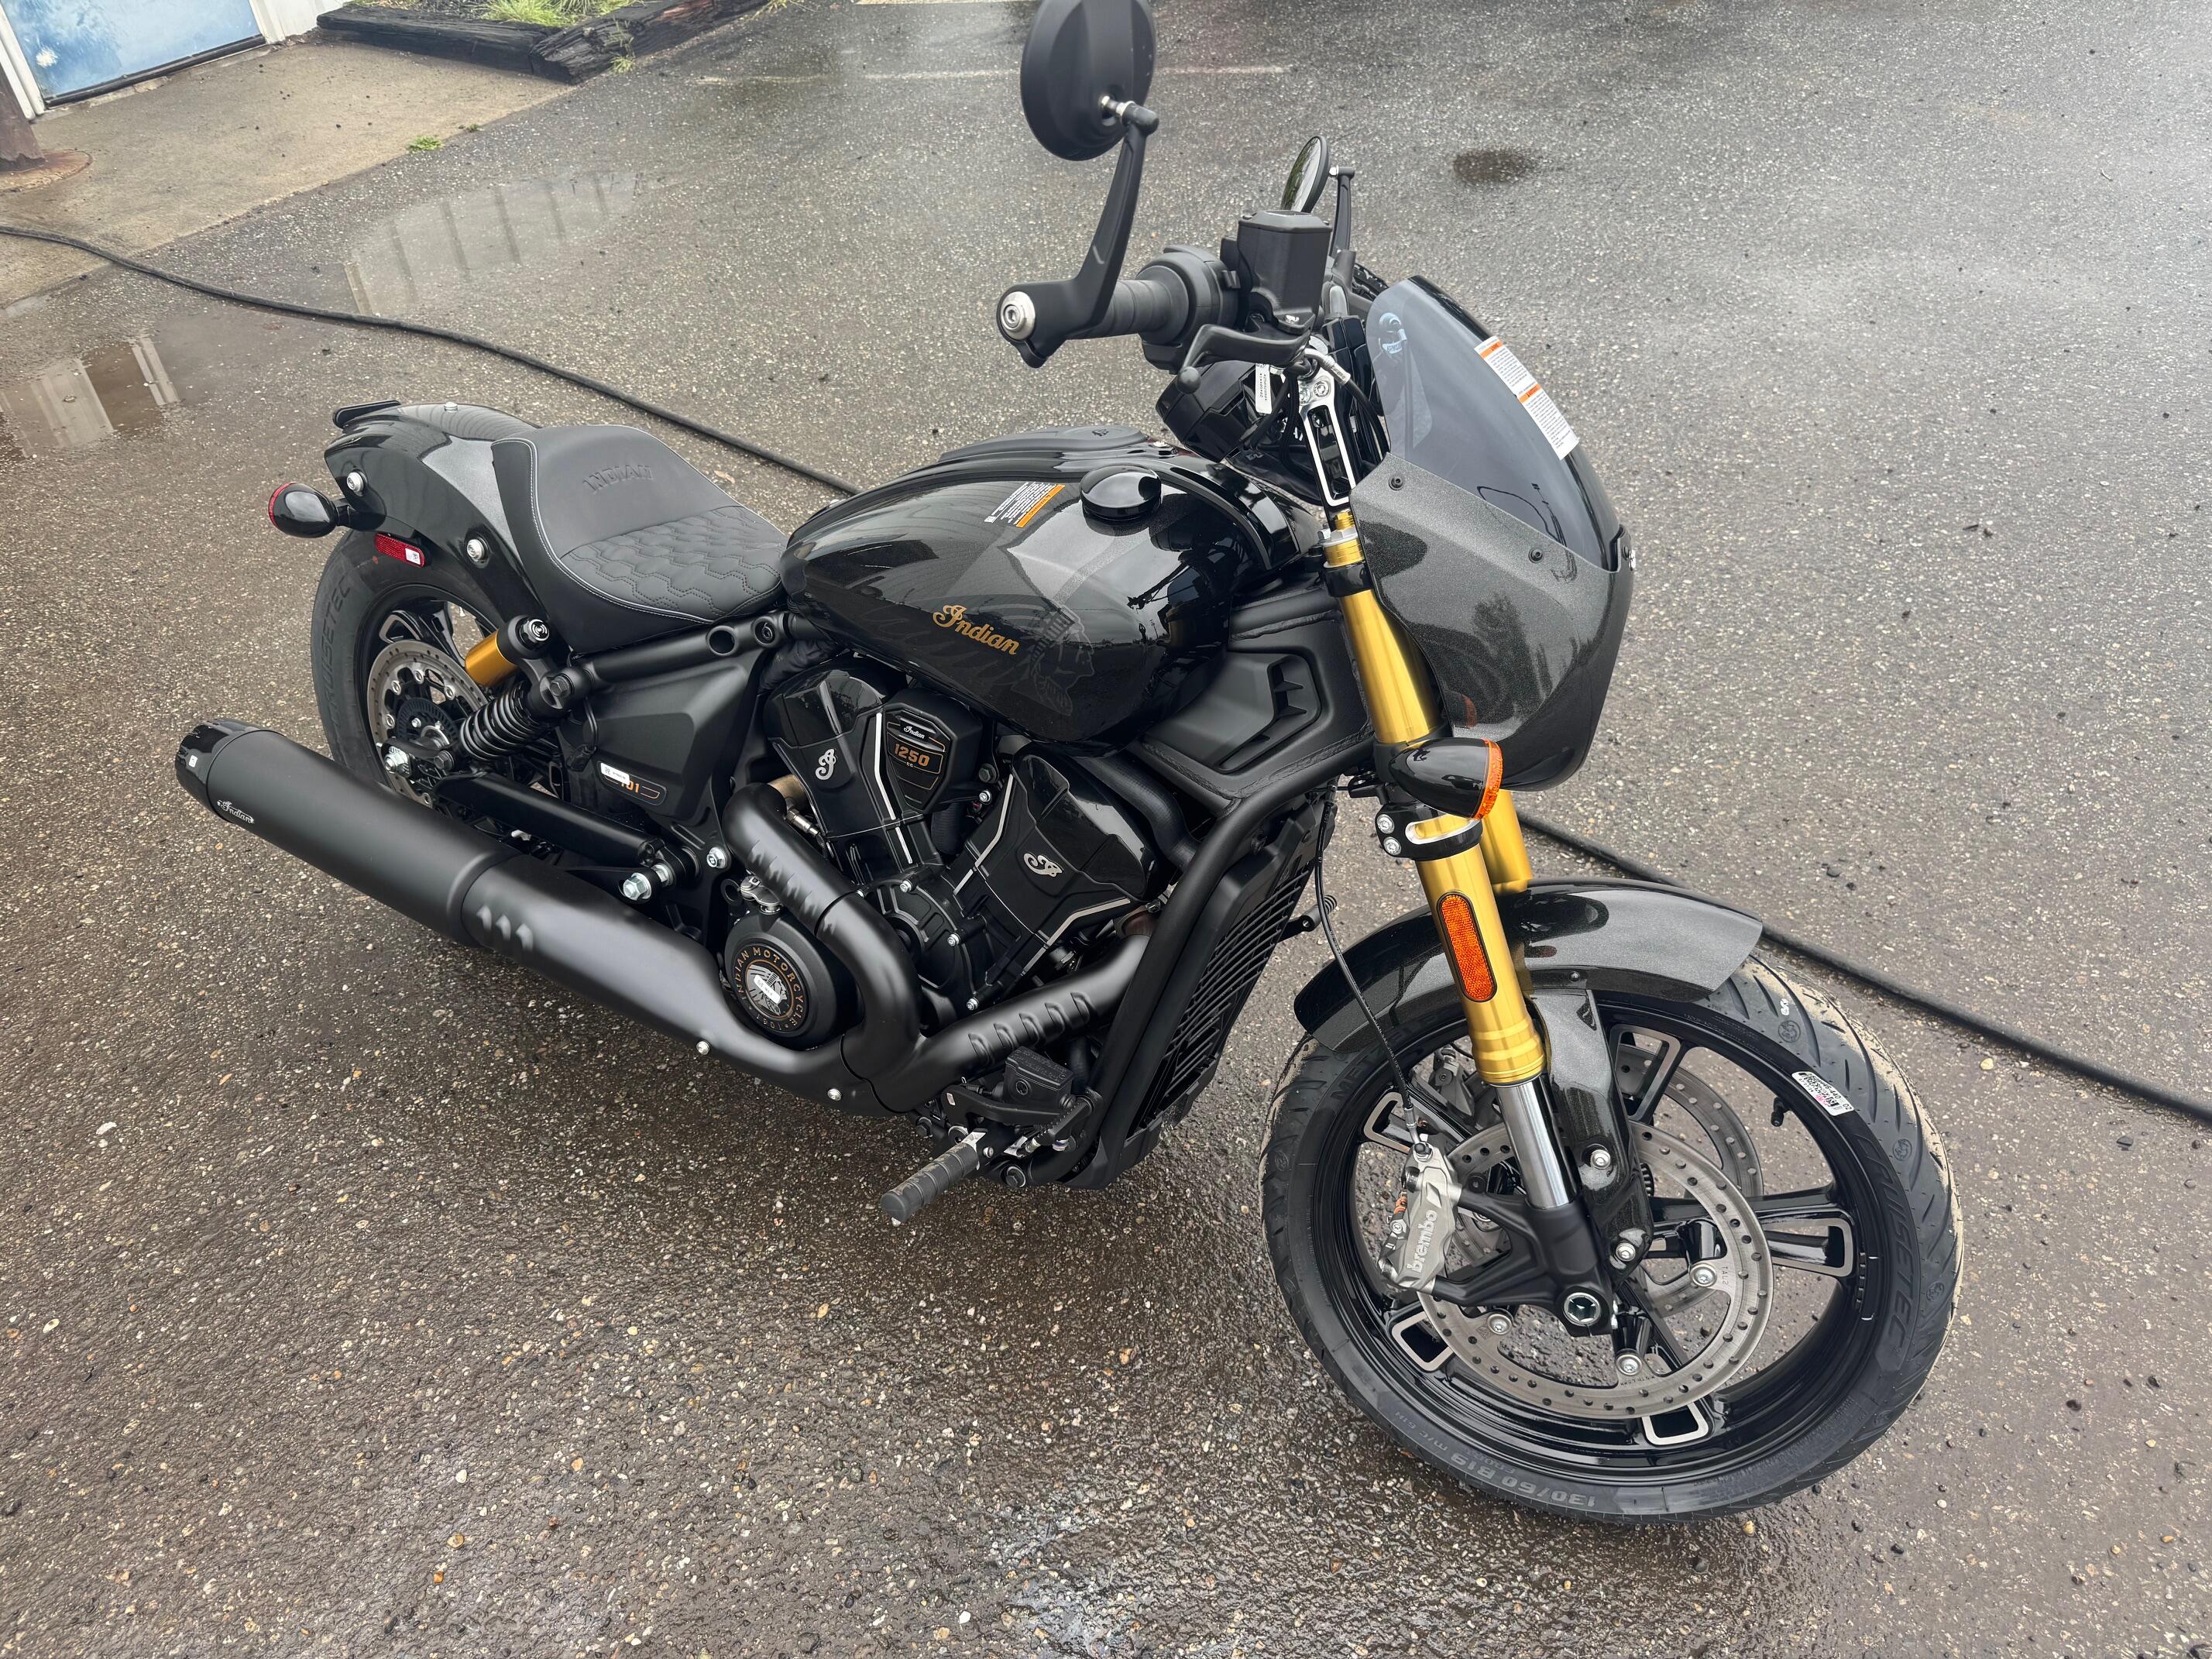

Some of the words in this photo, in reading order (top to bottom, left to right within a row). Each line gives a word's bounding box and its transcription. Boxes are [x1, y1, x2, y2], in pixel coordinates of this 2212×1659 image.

[582, 465, 653, 493] INDIAN
[933, 604, 1020, 655] Indian
[903, 726, 926, 740] Indian
[895, 744, 930, 767] 1250
[221, 801, 252, 823] Indian
[753, 946, 805, 1026] MOTORCYCLE
[1406, 1210, 1438, 1273] brembo
[1853, 1133, 1914, 1348] CRUISETEC
[1500, 1475, 1595, 1508] 130/60
